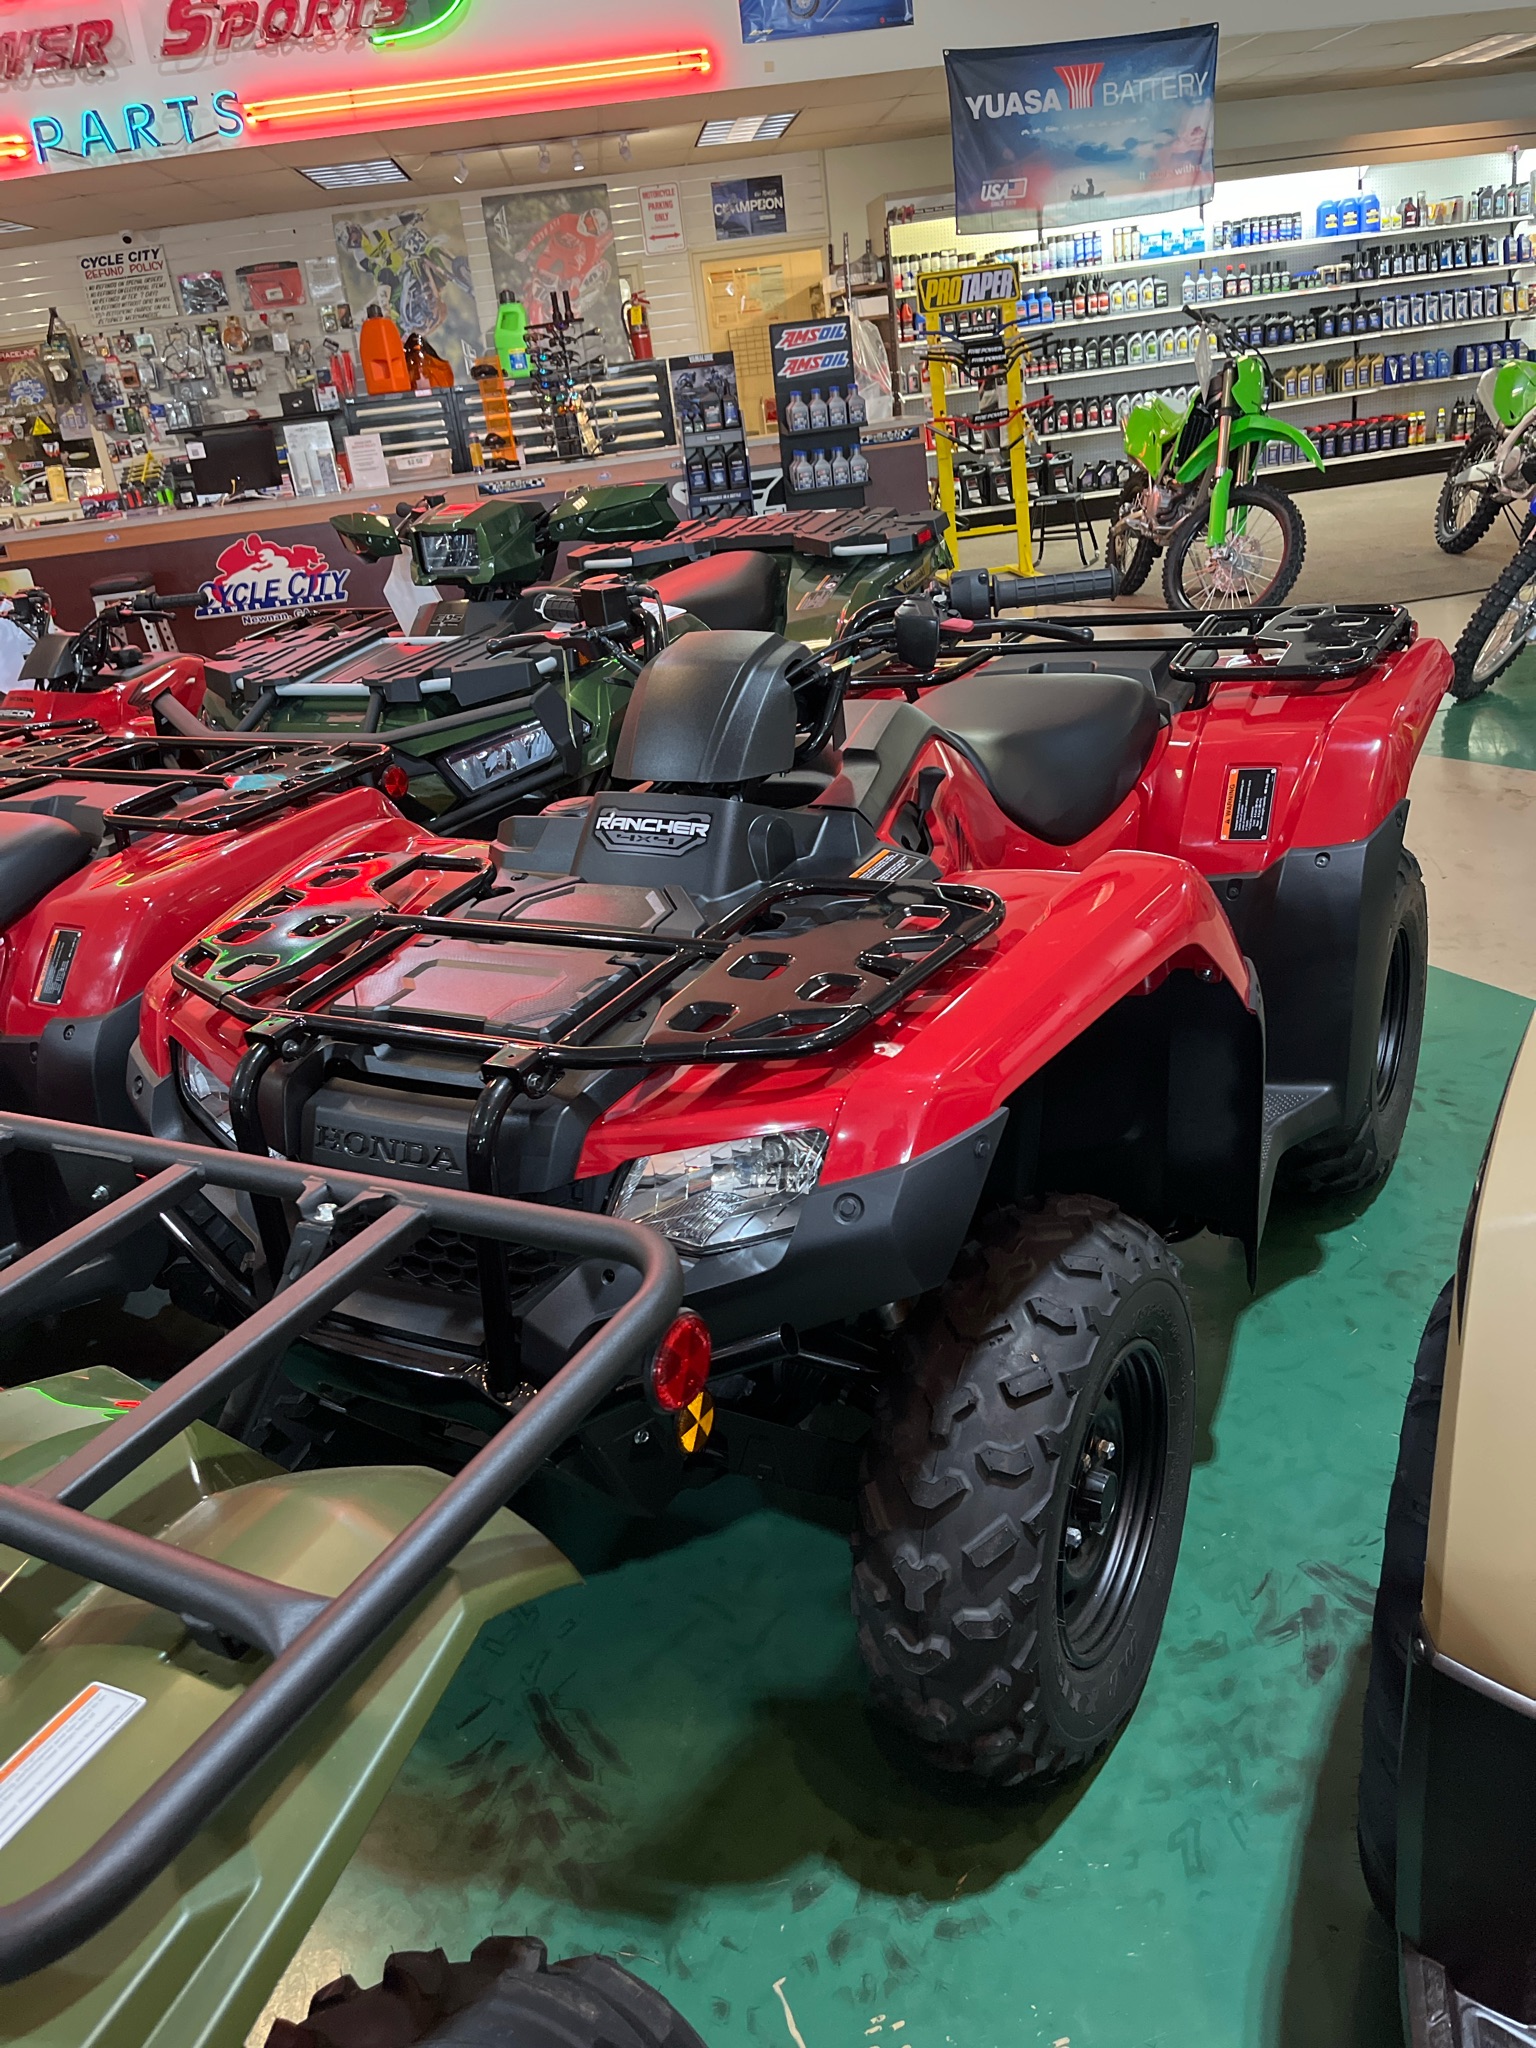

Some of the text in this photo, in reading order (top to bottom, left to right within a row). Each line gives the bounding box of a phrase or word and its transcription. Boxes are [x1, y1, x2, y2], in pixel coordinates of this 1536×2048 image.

[964, 71, 1209, 120] YUASA BATTERY
[29, 90, 244, 164] PARTS
[642, 188, 675, 200] MOTORCYCLE
[981, 183, 1010, 201] USA
[647, 200, 674, 211] PARKING
[654, 212, 669, 222] ONLY
[81, 248, 160, 269] CYCLE CITY
[85, 261, 164, 280] REFUND POLICY
[926, 269, 1015, 306] PROTAPER
[777, 323, 847, 350] AMSOIL
[779, 351, 849, 377] AMSOIL
[198, 568, 350, 609] CYCLE CITY
[207, 593, 338, 616] POWER SPORTS
[242, 610, 293, 626] Newnan,
[1225, 784, 1236, 816] WARNING
[595, 811, 710, 837] RANCHER
[314, 1125, 463, 1175] HONDA
